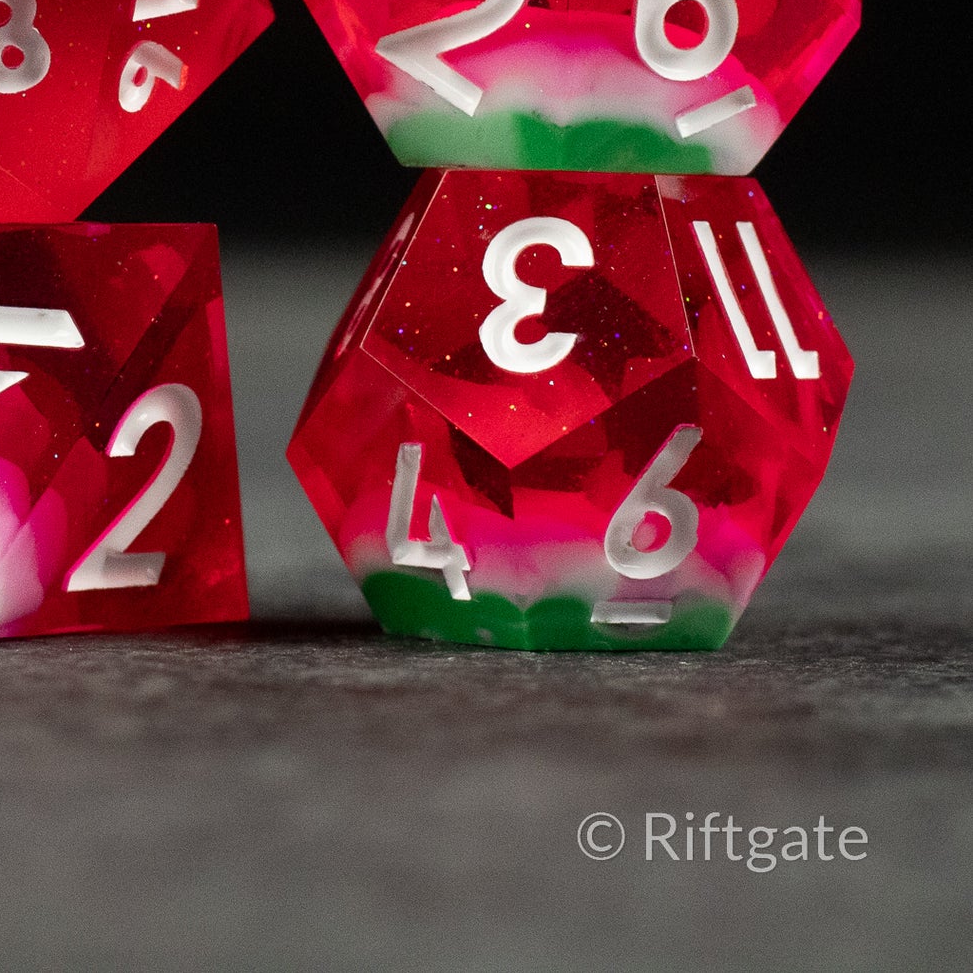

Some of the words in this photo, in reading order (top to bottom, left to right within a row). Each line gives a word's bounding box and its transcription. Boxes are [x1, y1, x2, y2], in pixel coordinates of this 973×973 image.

[478, 215, 595, 374] 3
[691, 219, 820, 381] 11
[62, 382, 203, 593] 2
[385, 441, 477, 602] 4
